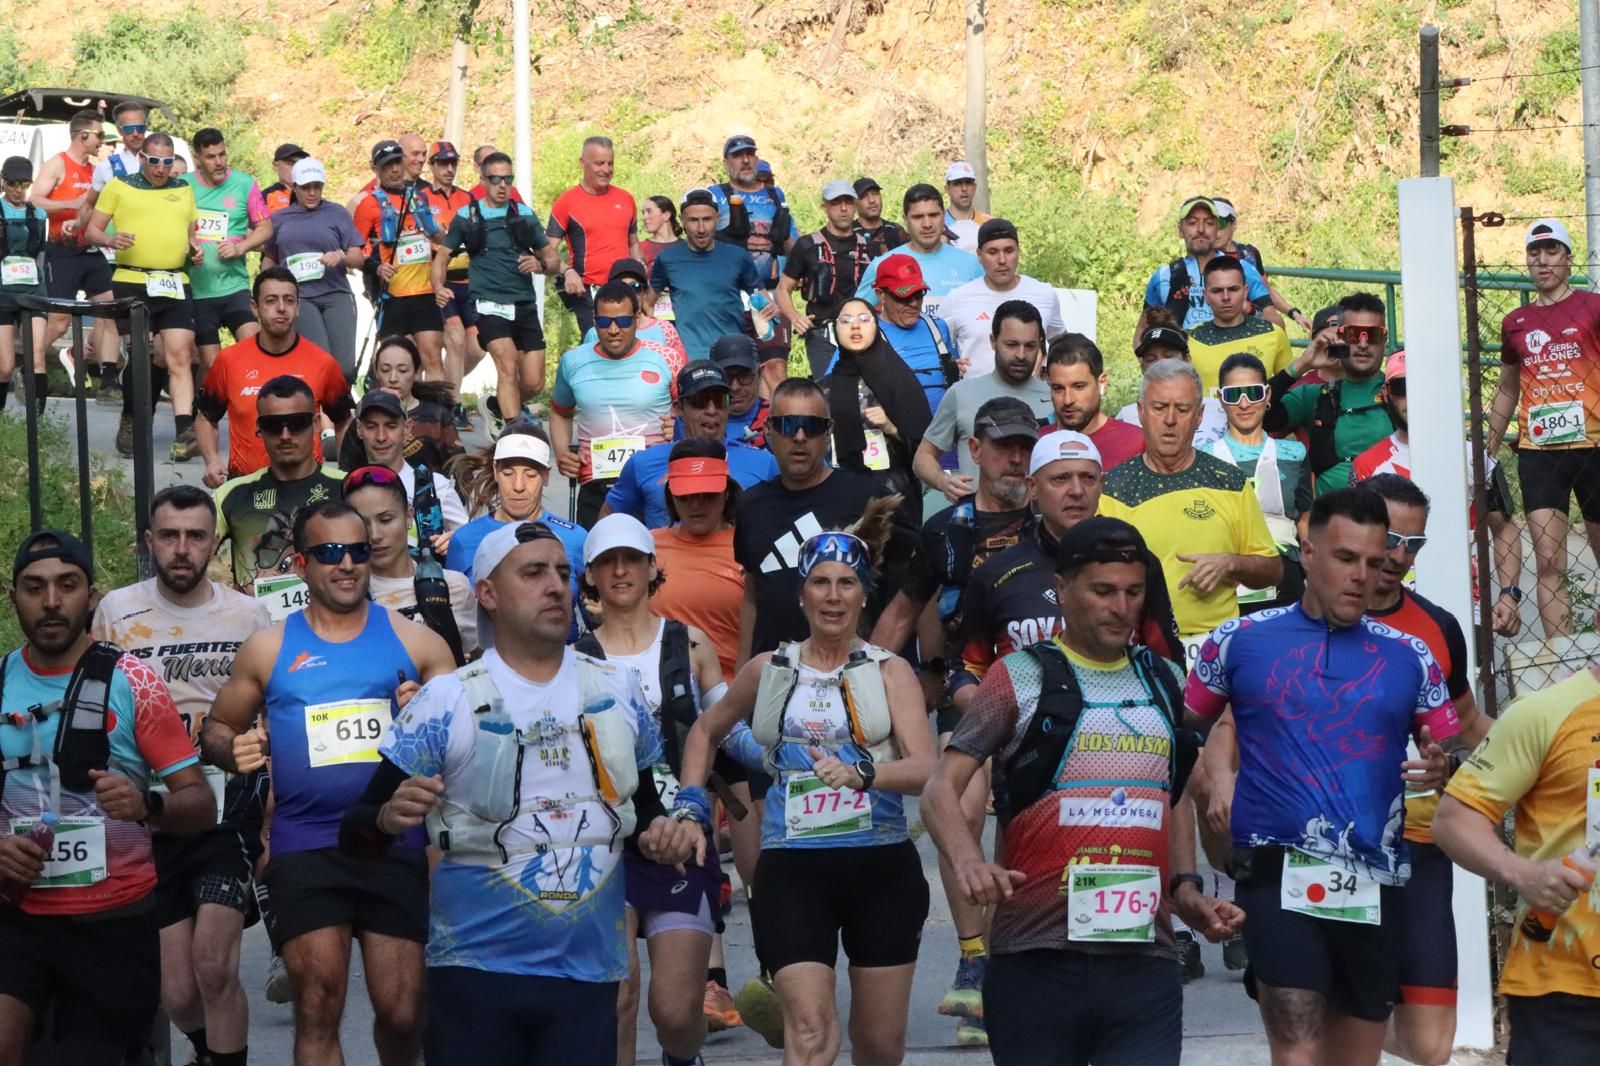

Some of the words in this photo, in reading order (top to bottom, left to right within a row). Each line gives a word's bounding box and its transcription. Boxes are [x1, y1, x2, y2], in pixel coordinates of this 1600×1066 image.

[201, 219, 221, 231] 275
[413, 244, 424, 253] 35
[20, 265, 29, 274] 52
[300, 261, 317, 271] 190
[1524, 348, 1581, 367] BULLONES
[1540, 413, 1581, 430] 180-1
[258, 585, 273, 594] 21K
[1007, 616, 1056, 651] SOY
[157, 641, 243, 657] FUERTES
[311, 712, 329, 722] 10K
[336, 717, 381, 741] 619
[1078, 732, 1113, 753] LOS
[803, 788, 866, 815] 177-2
[1069, 807, 1086, 817] LA
[1093, 807, 1158, 819] MELONERA
[1074, 876, 1097, 887] 21K
[1327, 870, 1358, 896] 34
[540, 891, 579, 901] RONDA
[1094, 890, 1158, 915] 176-2
